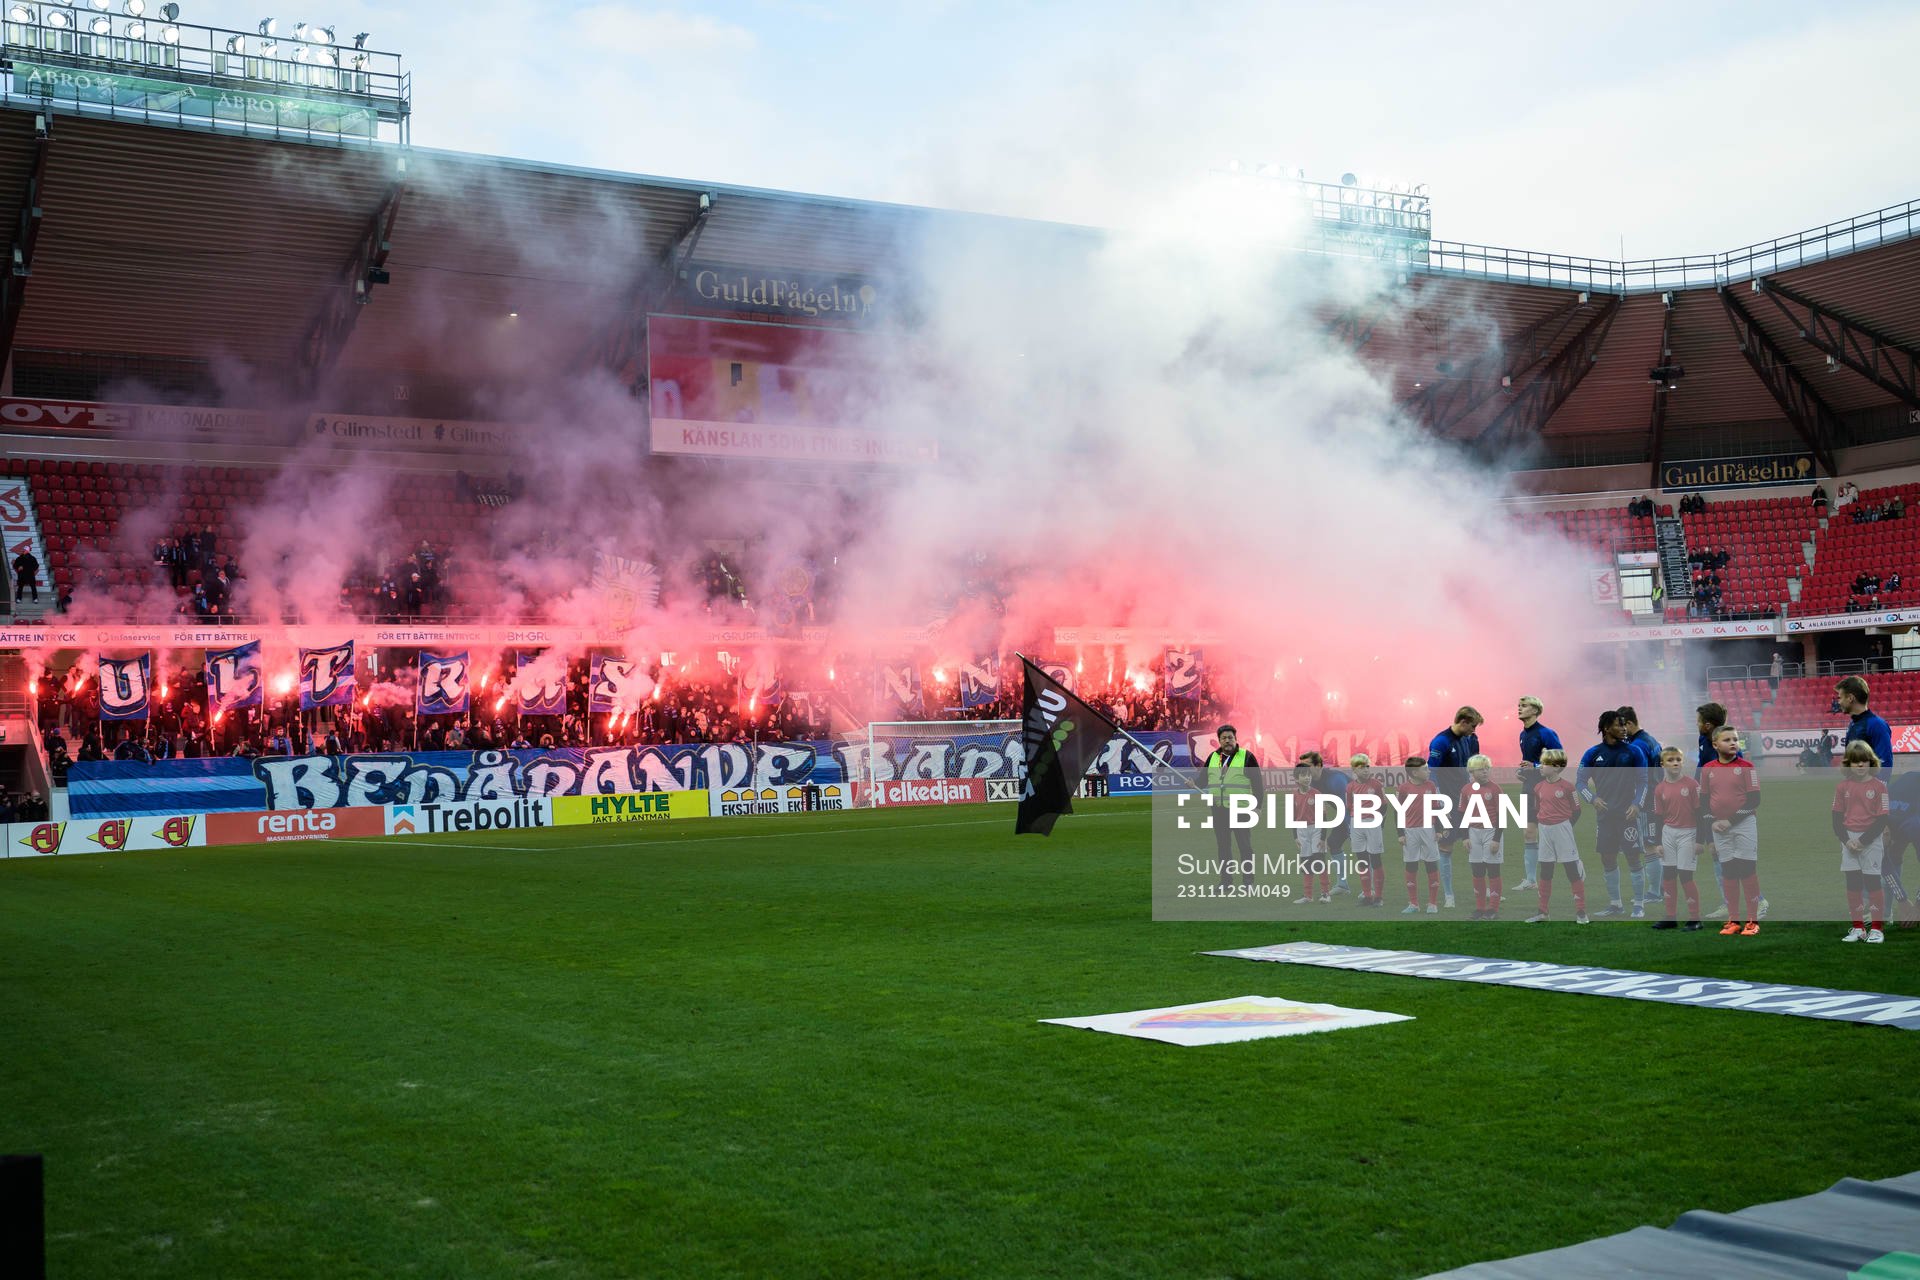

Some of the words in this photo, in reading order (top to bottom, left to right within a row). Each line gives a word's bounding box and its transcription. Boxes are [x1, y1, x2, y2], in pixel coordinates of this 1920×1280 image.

[27, 67, 91, 89] ÅBRO
[217, 93, 275, 113] ÅBRO
[695, 270, 857, 316] GuldFågeln
[332, 420, 424, 441] Glimstedt
[682, 426, 763, 449] KÄNSLAN
[1665, 460, 1795, 487] GuldFågeln
[33, 633, 76, 642] INTRYCK
[174, 631, 193, 641] FÖR
[195, 633, 212, 641] ETT
[214, 631, 248, 641] BÄTTRE
[376, 631, 394, 640] FÖR
[396, 632, 411, 640] ETT
[413, 630, 444, 640] BÄTTRE
[445, 632, 480, 641] INTRYCK
[1671, 628, 1684, 636] ICA
[1692, 627, 1705, 635] ICA
[1713, 626, 1727, 634] ICA
[1735, 625, 1748, 633] ICA
[1756, 624, 1770, 632] ICA
[1775, 736, 1821, 749] SCANIA
[889, 779, 972, 804] elkedjan
[591, 794, 670, 815] HYLTE
[258, 810, 336, 834] renta
[420, 799, 544, 833] Trebolit
[592, 815, 613, 824] JAKT
[617, 814, 622, 823] &
[626, 813, 671, 822] LANTMAN
